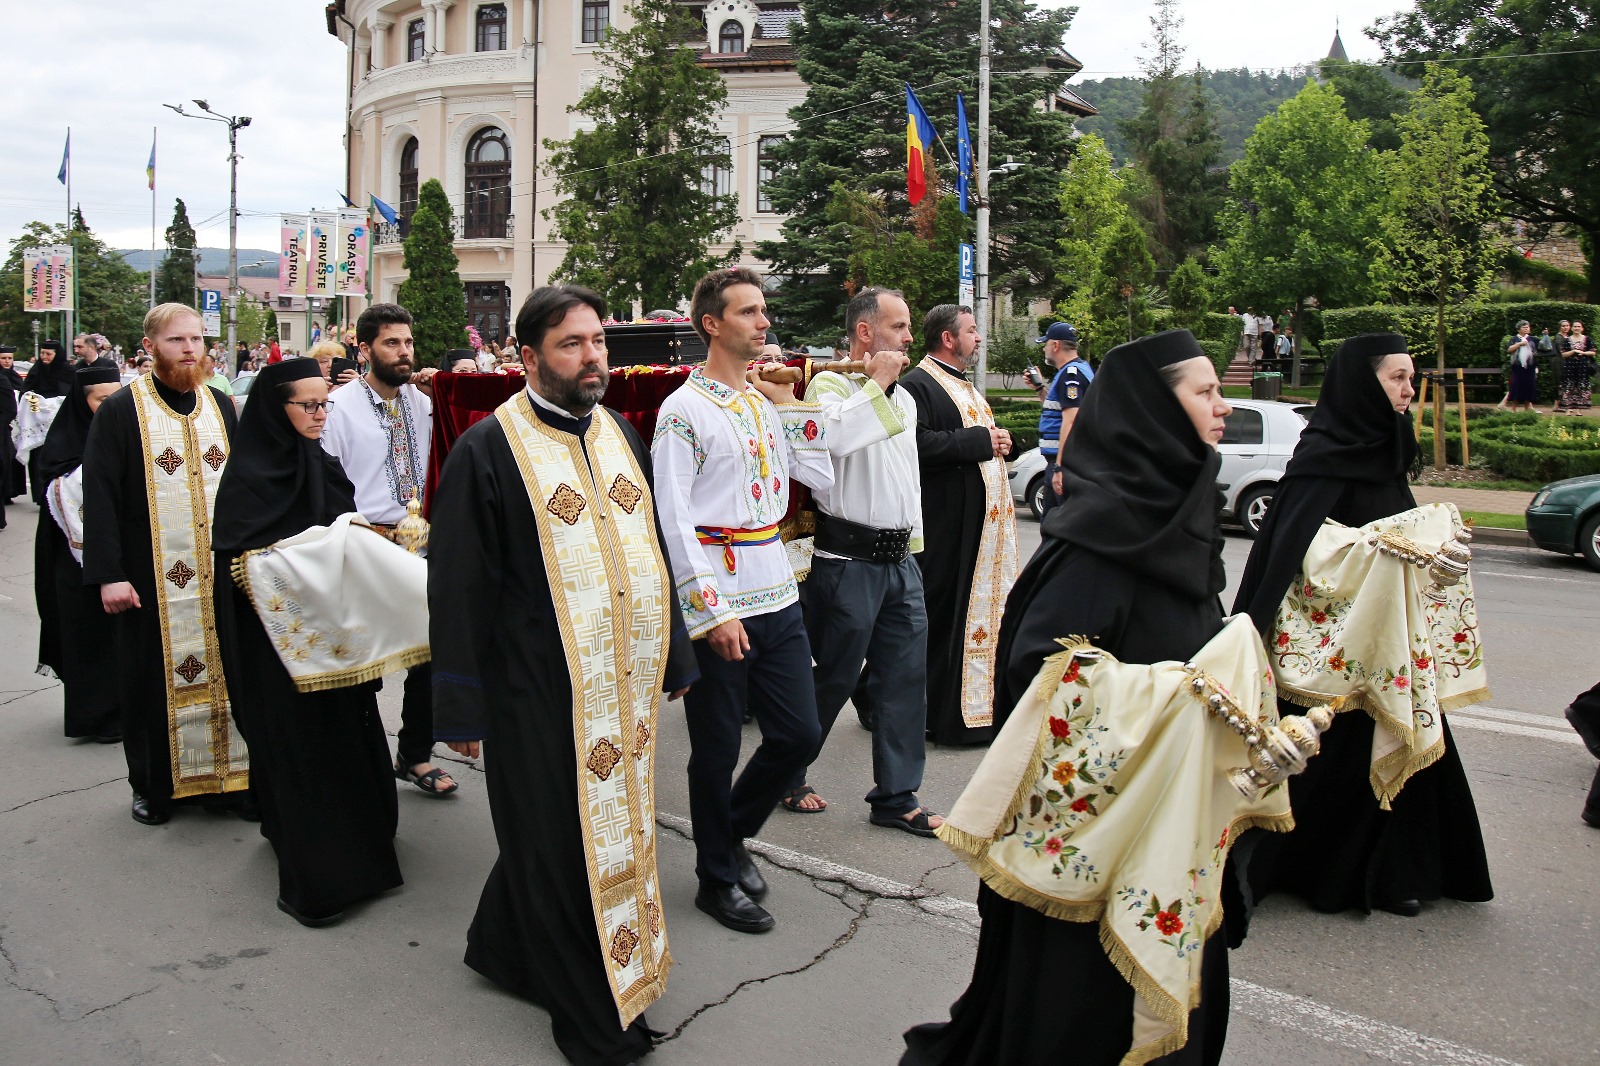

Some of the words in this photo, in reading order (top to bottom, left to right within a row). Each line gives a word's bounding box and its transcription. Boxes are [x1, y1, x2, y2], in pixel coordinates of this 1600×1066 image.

[288, 237, 298, 286] TEATRUL
[962, 245, 971, 277] P
[206, 291, 218, 310] P
